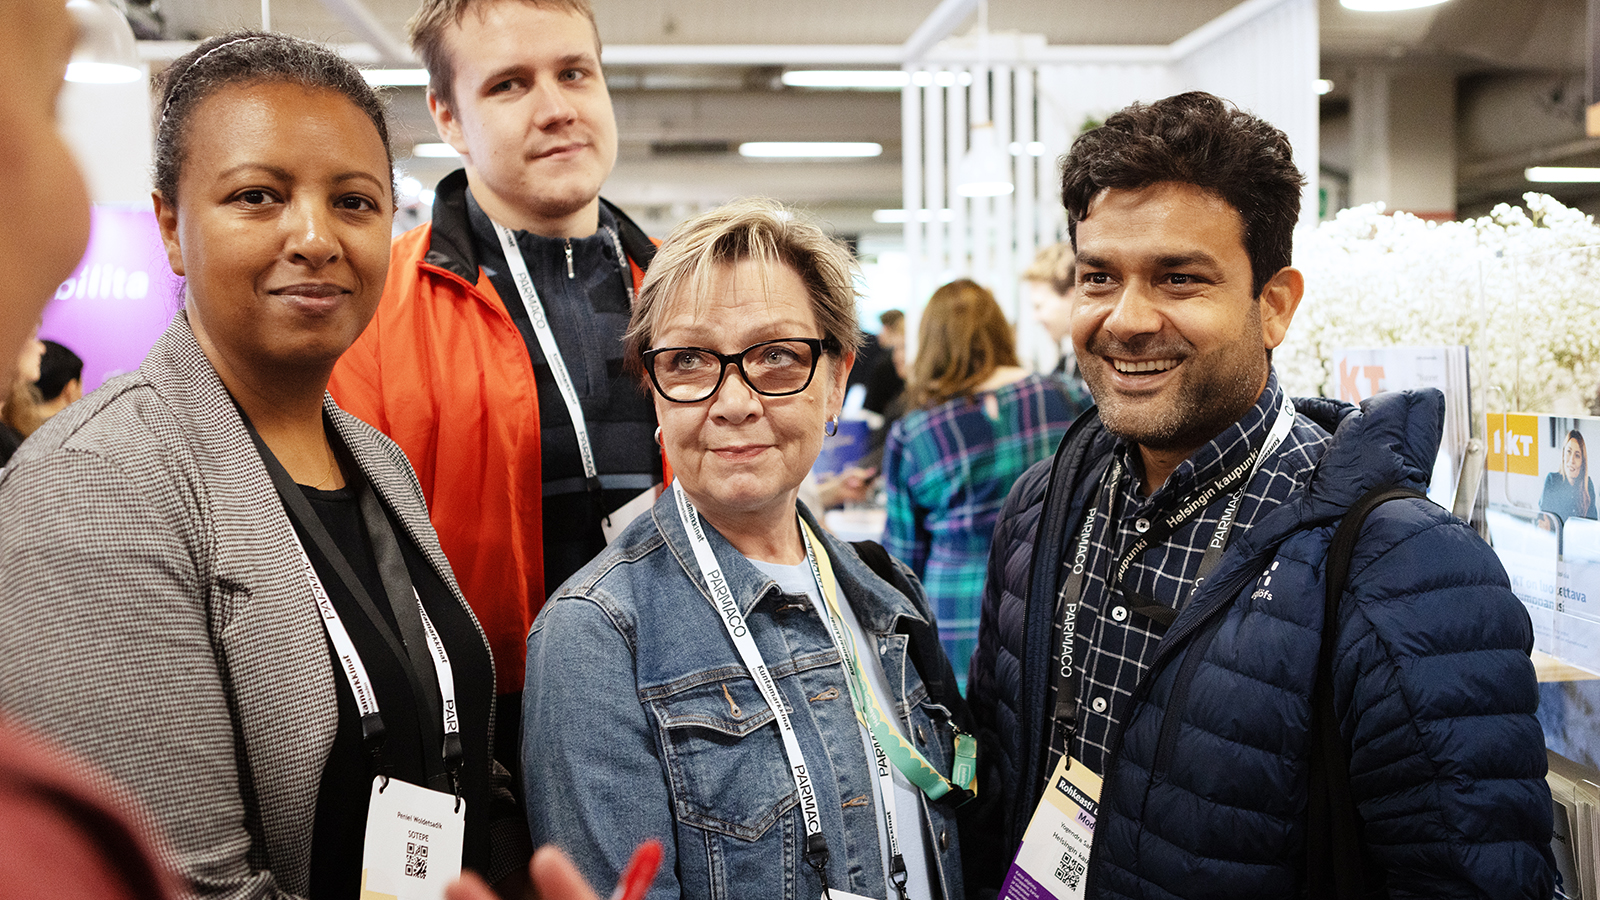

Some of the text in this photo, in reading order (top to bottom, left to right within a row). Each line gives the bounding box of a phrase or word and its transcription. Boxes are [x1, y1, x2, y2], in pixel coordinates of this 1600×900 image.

[516, 272, 546, 330] PARMACO
[1166, 486, 1216, 528] Helsingin
[1214, 448, 1260, 492] kaupunki
[1072, 507, 1097, 575] PARMACO
[707, 569, 747, 638] PARMACO
[1060, 603, 1077, 678] PARMACO
[757, 665, 792, 731] Kuntamarkkinat
[396, 811, 413, 822] Peniel
[794, 764, 820, 832] PARMAC
[1058, 779, 1094, 811] Rohkeasti
[407, 830, 430, 843] SOTEPE
[1052, 831, 1078, 856] Helsingin
[1060, 821, 1083, 844] Yogendra
